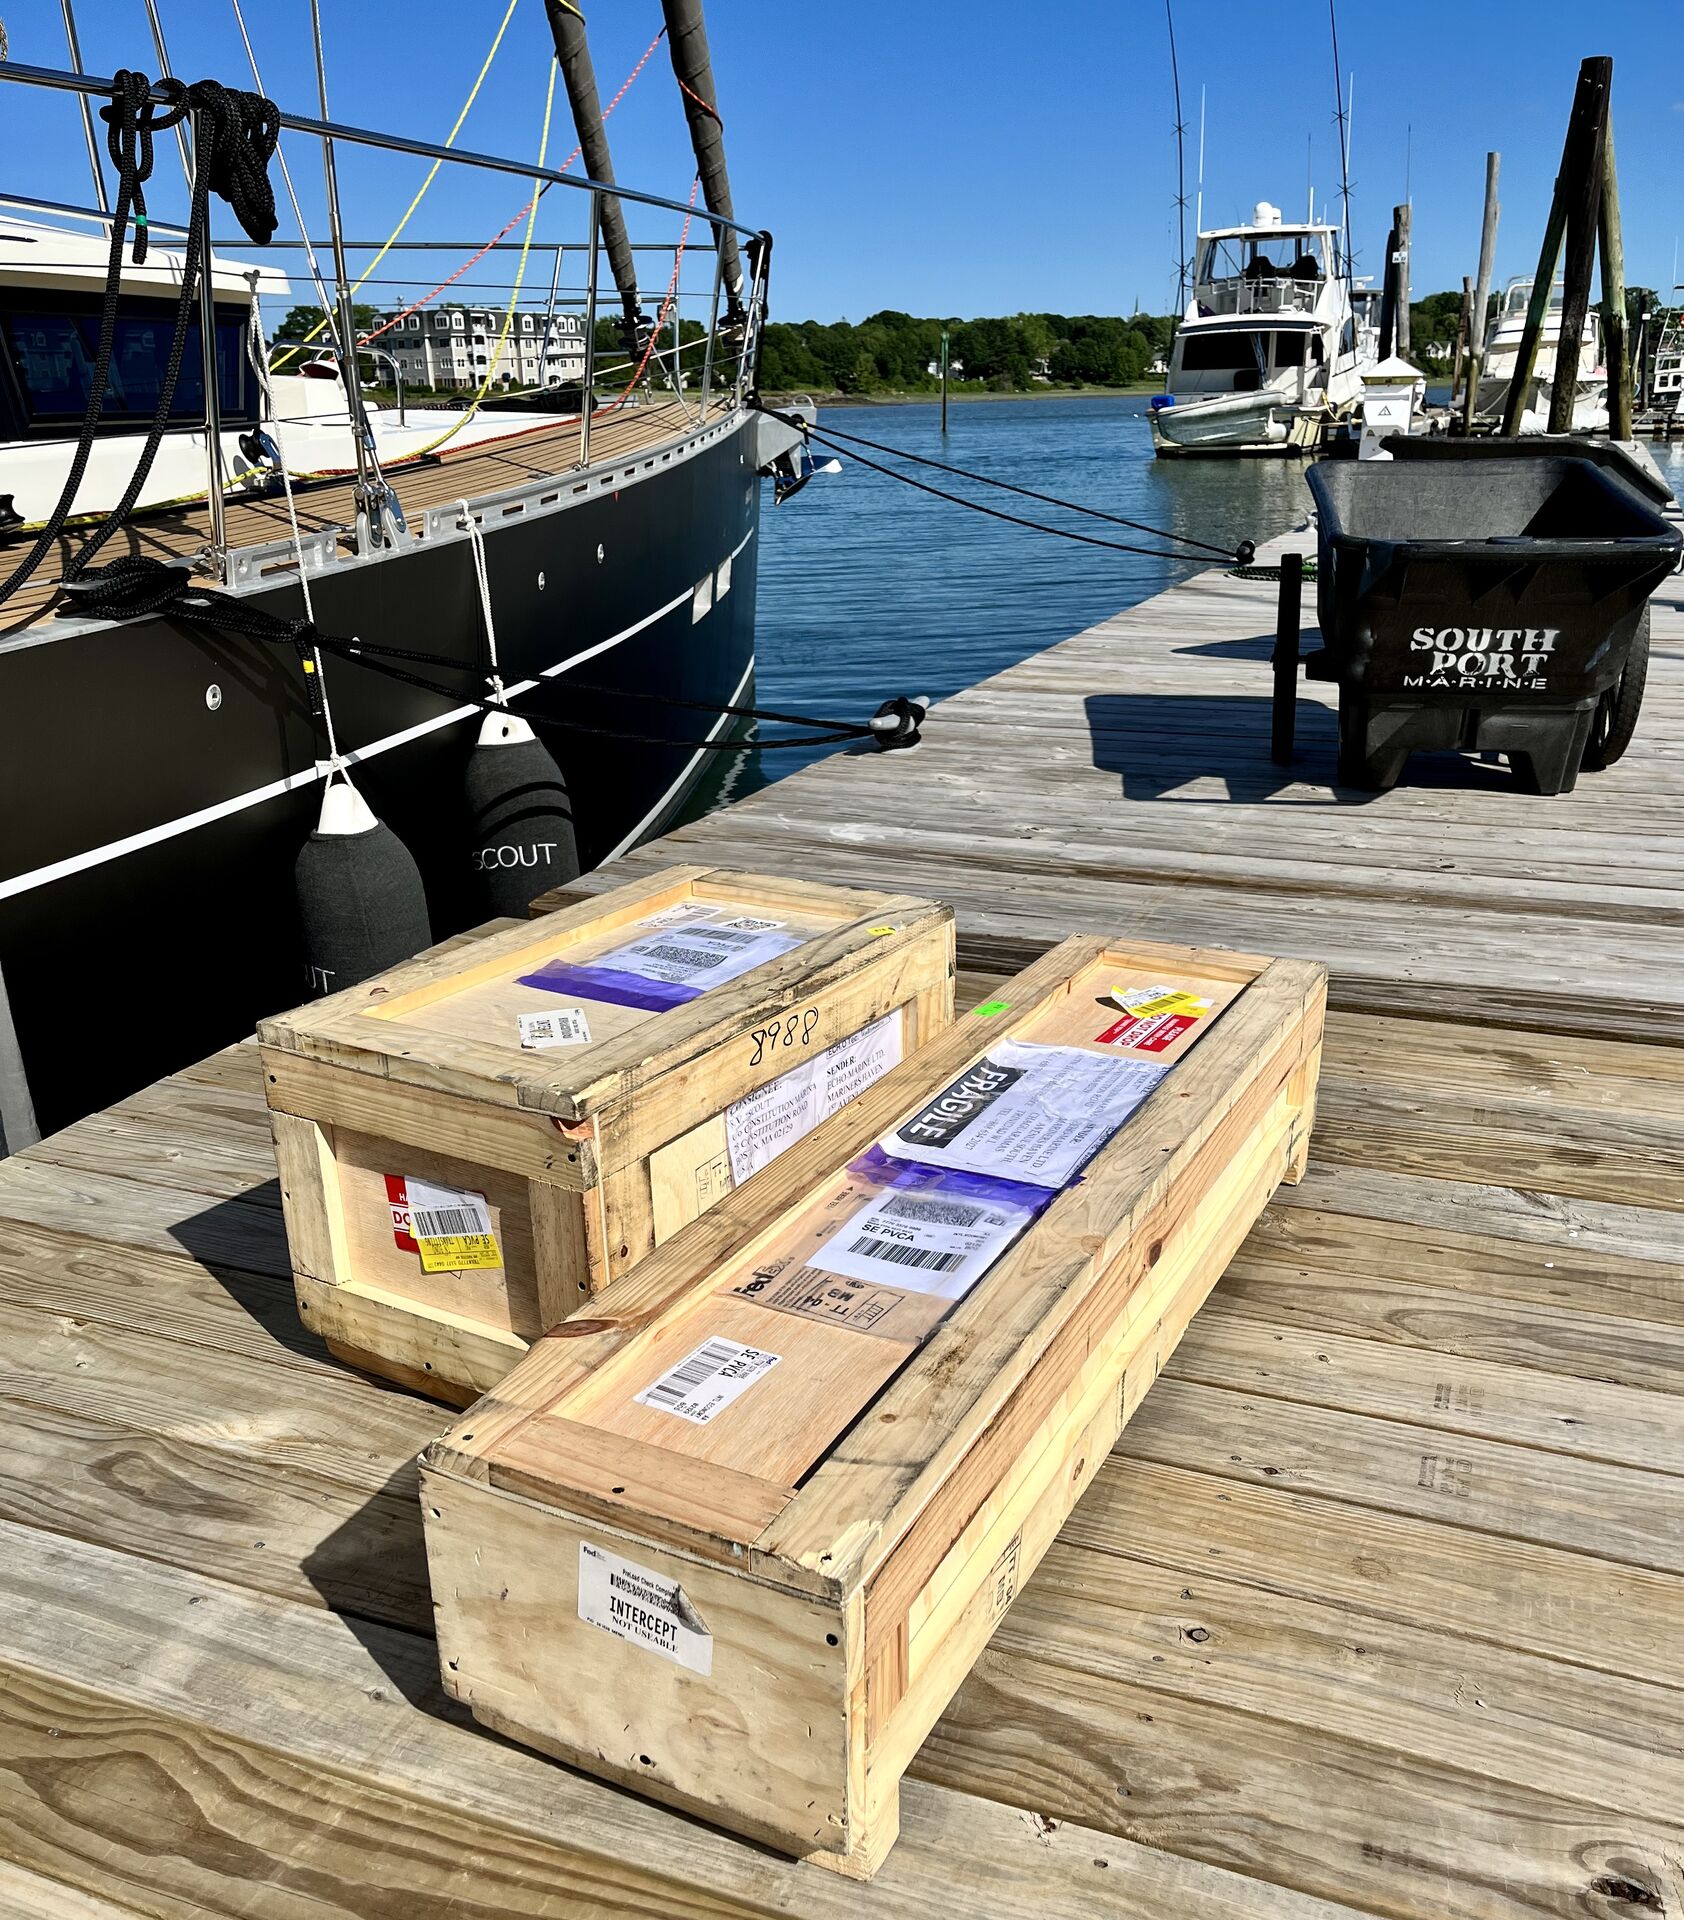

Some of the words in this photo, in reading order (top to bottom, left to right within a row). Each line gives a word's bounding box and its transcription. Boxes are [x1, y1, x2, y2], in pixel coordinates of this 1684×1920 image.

[1410, 627, 1561, 651] SOUTH
[1429, 651, 1549, 679] PORT
[471, 843, 558, 871] SCOUT
[749, 1006, 819, 1067] 8988
[1139, 1019, 1155, 1032] NOT
[1120, 1030, 1143, 1047] DROP
[826, 1055, 857, 1078] SENDER:
[794, 1083, 817, 1103] MARINA
[827, 1079, 861, 1104] MARINERS
[862, 1063, 884, 1083] HAVEN
[792, 1100, 809, 1118] ROAD
[910, 1066, 1008, 1138] FRAGILE
[462, 1235, 480, 1245] PVCA
[861, 1223, 881, 1234] SE
[880, 1228, 915, 1241] PVCA
[732, 1257, 790, 1298] FedEx
[740, 1349, 760, 1361] SE
[718, 1360, 746, 1378] PVCA
[641, 1577, 654, 1589] Check
[610, 1596, 678, 1641] INTERCEPT
[612, 1615, 633, 1631] NOT
[634, 1628, 679, 1654] USEABLE
